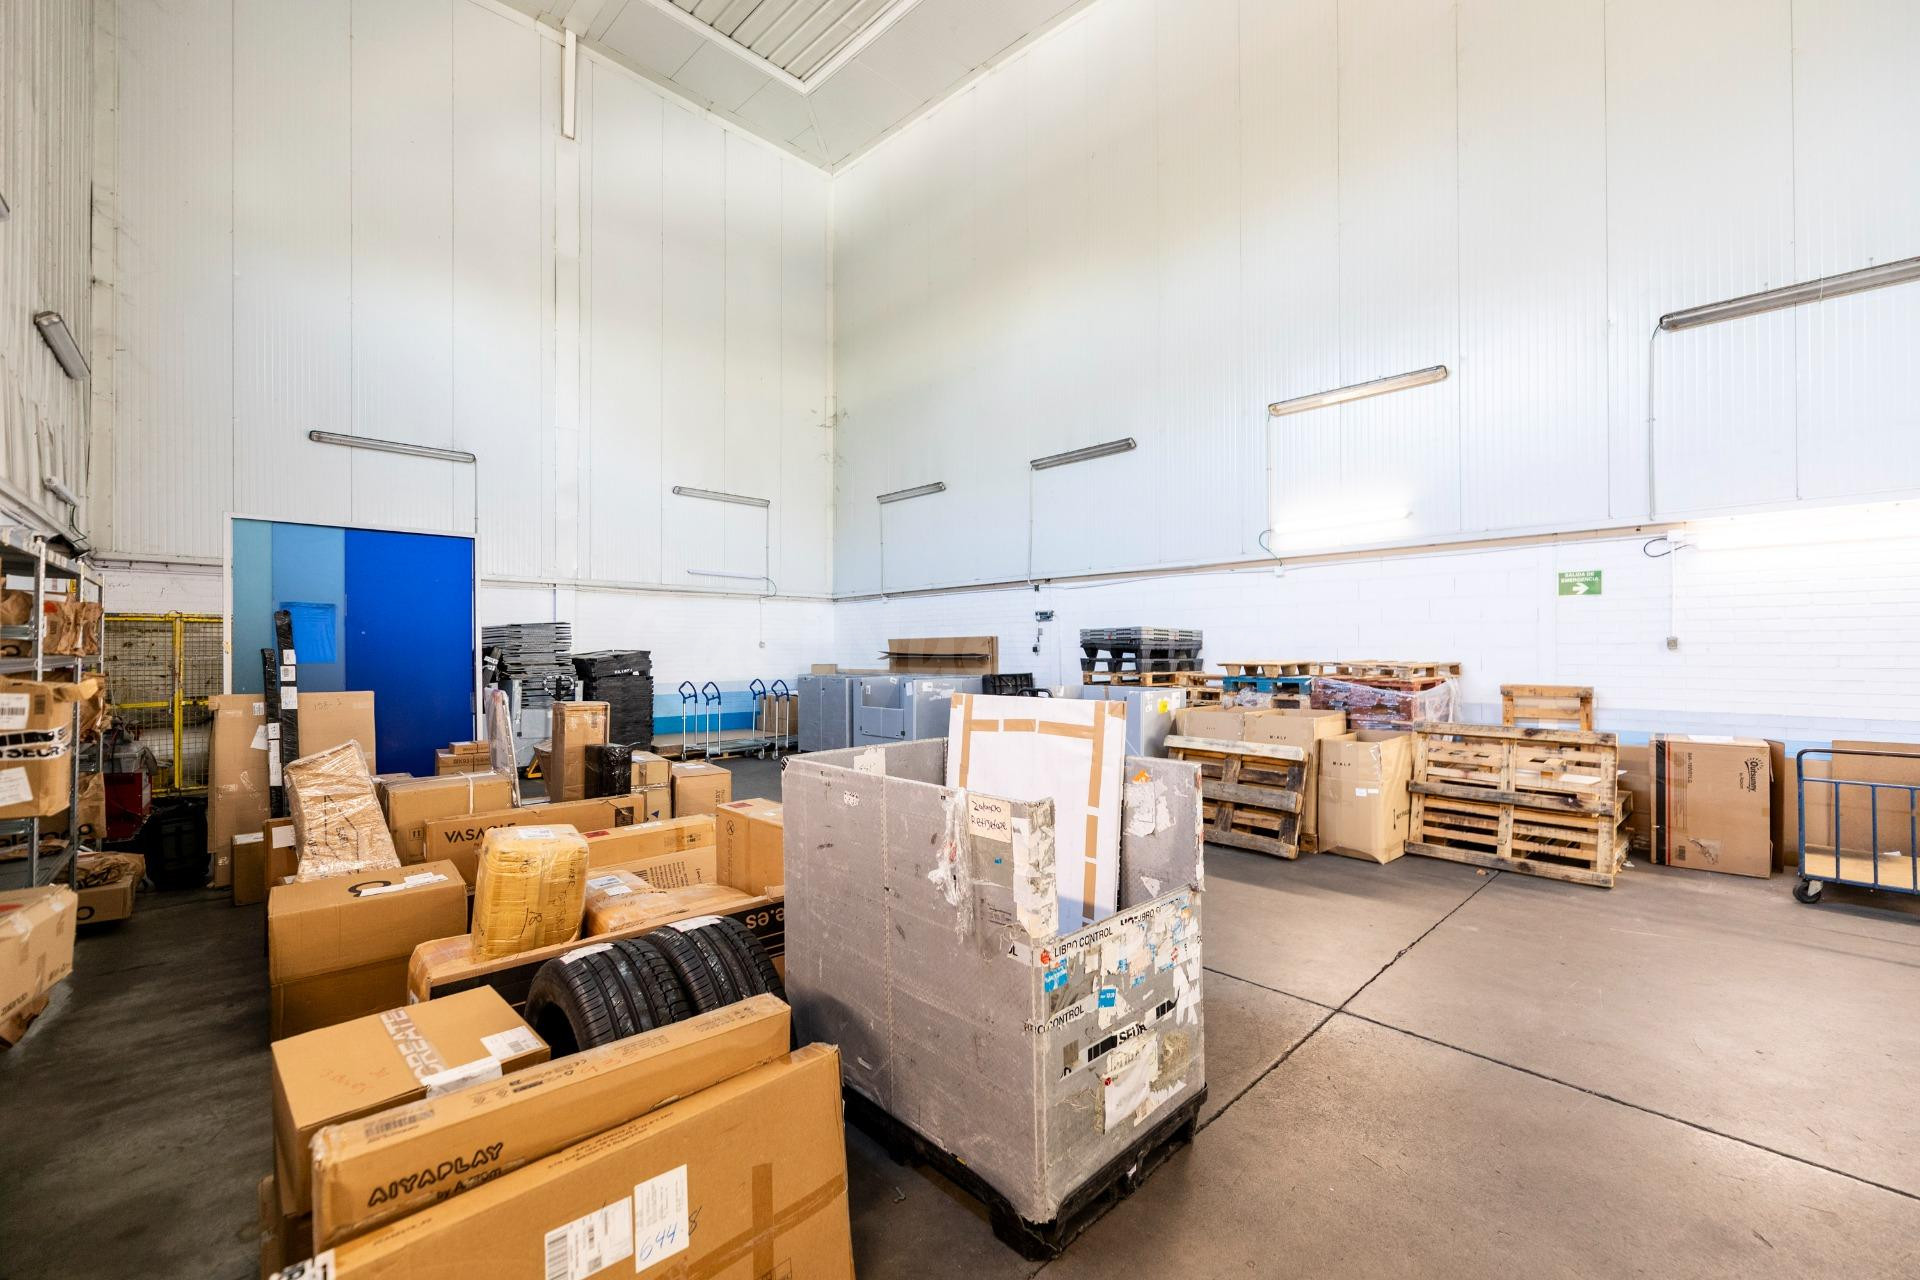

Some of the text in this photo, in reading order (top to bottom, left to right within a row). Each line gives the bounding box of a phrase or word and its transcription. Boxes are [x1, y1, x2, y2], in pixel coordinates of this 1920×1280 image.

[1748, 760, 1758, 792] Outsunny
[1079, 926, 1113, 948] CONTROL
[368, 1142, 504, 1207] AIYAPLAY
